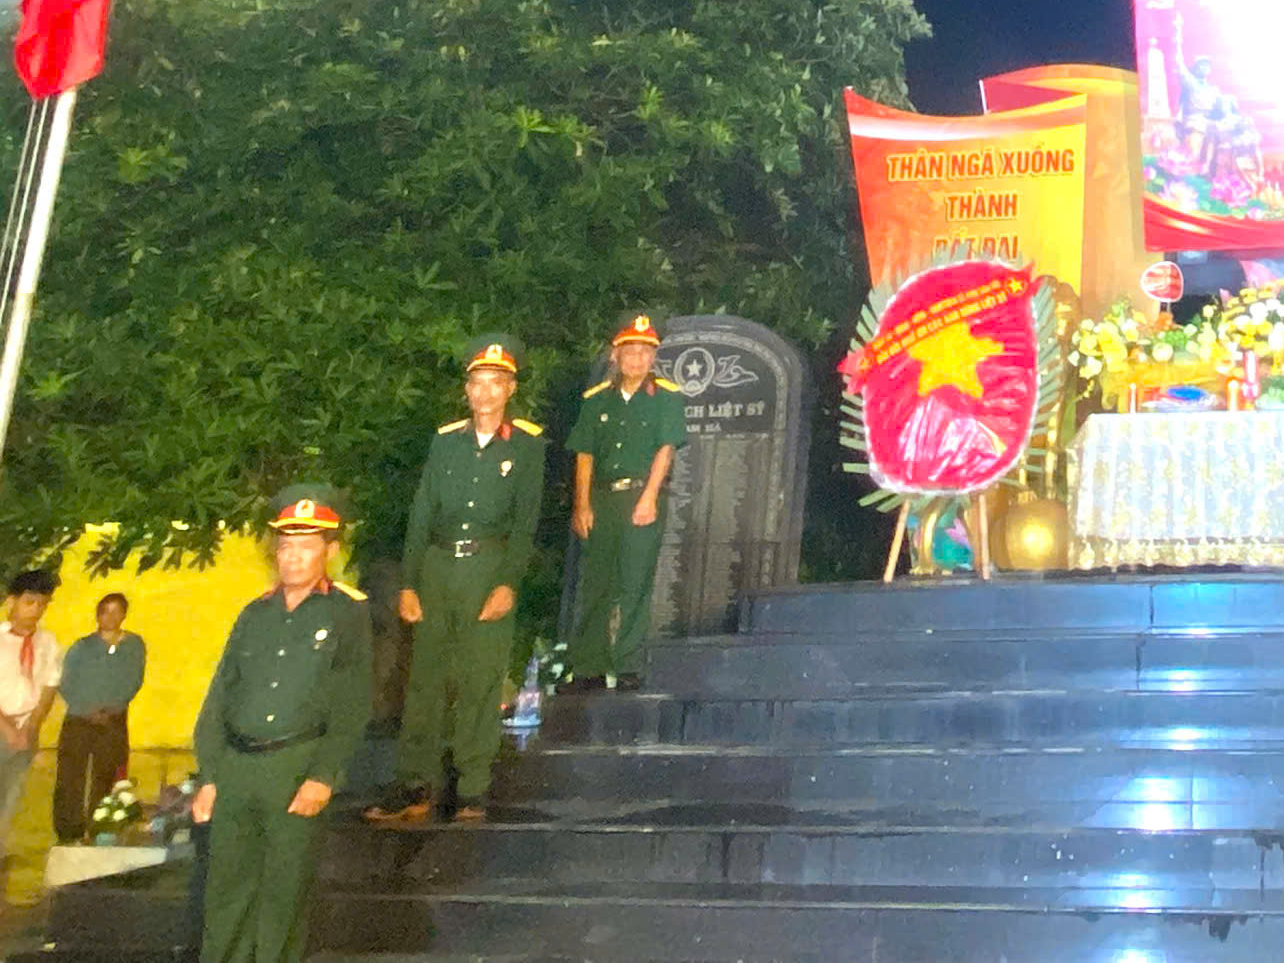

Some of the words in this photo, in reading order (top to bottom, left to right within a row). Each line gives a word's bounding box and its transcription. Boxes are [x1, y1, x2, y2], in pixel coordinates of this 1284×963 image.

[889, 149, 944, 180] THÂN
[1002, 144, 1075, 176] XUỐNG
[947, 188, 1018, 219] THÀNH
[684, 405, 705, 418] CH
